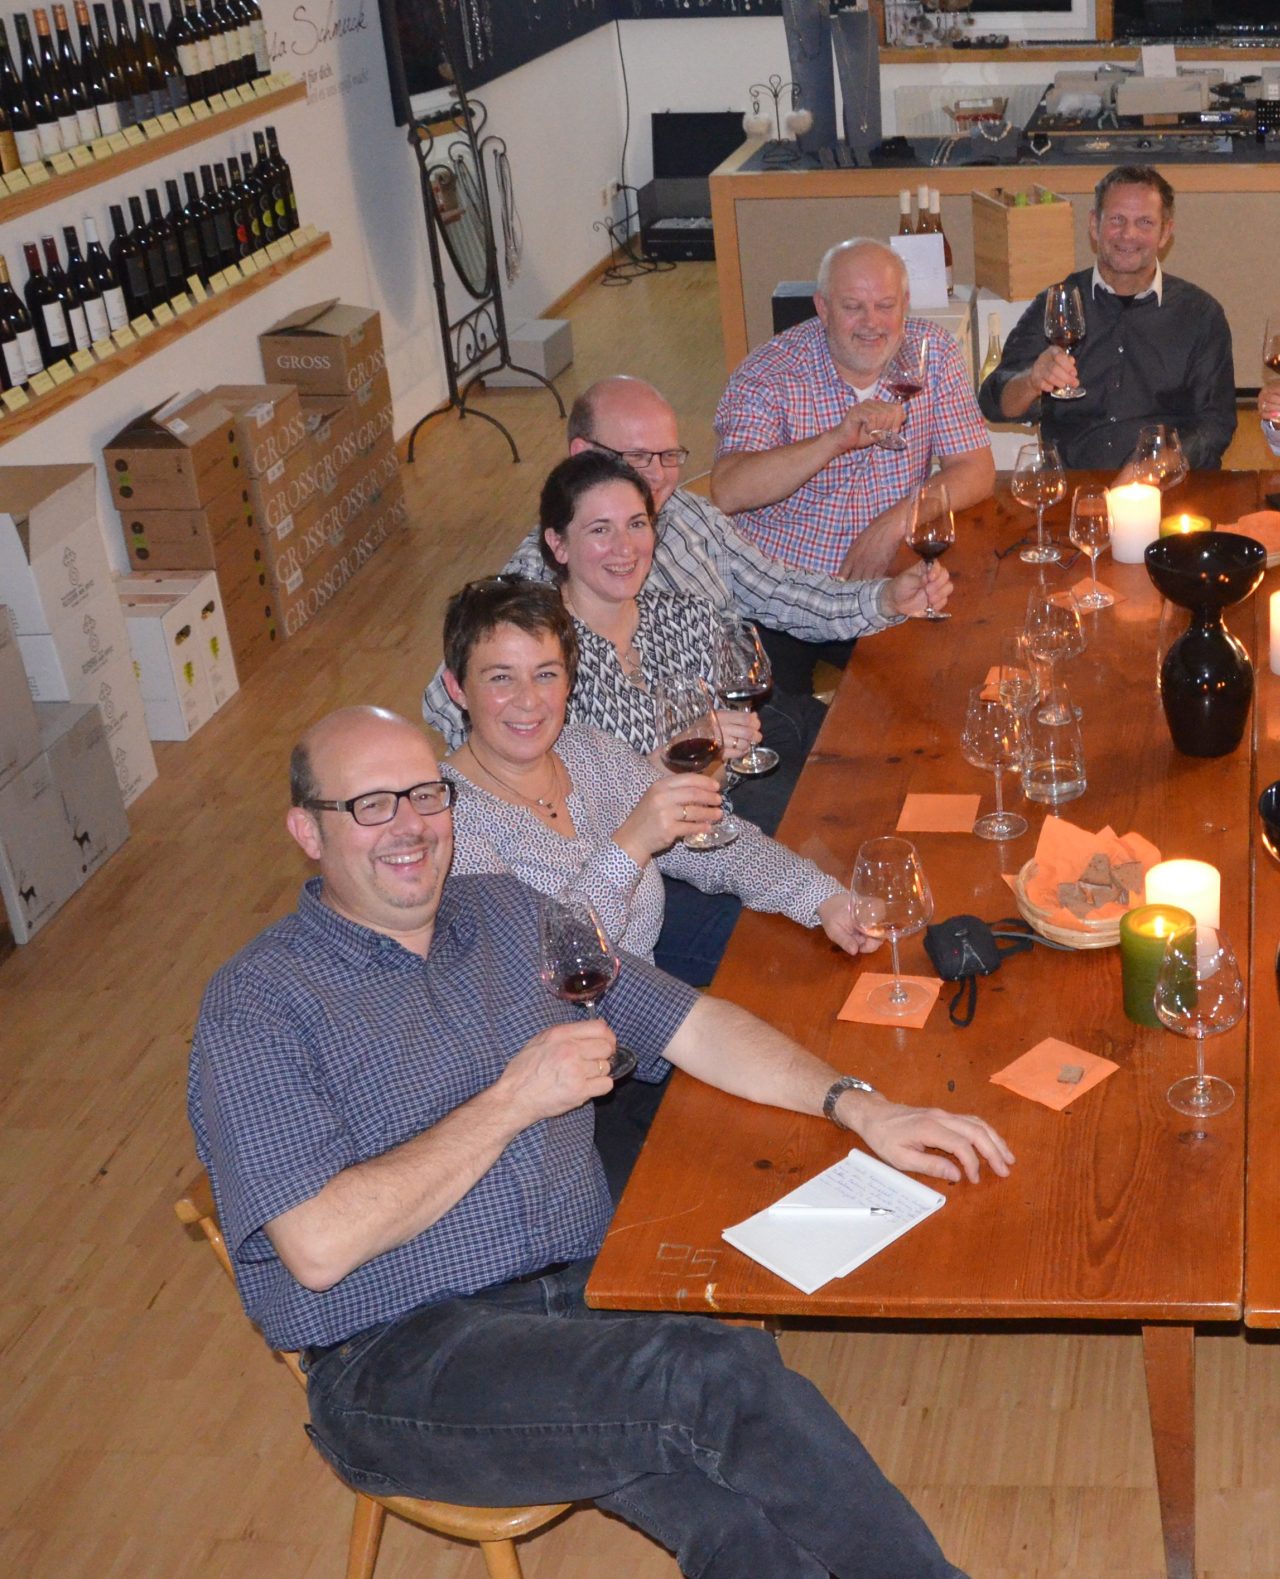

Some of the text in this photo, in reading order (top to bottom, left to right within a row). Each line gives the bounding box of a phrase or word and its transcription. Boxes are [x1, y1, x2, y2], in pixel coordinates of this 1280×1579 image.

[276, 355, 331, 369] GROSS
[347, 349, 385, 392] GROSS
[254, 412, 306, 473] GROSS
[357, 404, 394, 450] GROSS
[314, 431, 357, 490] GROSS
[265, 466, 316, 529] GROSS
[322, 487, 363, 540] GROSS
[277, 520, 328, 583] GROSS
[331, 537, 374, 592] GROSS
[286, 572, 333, 636] GROSS
